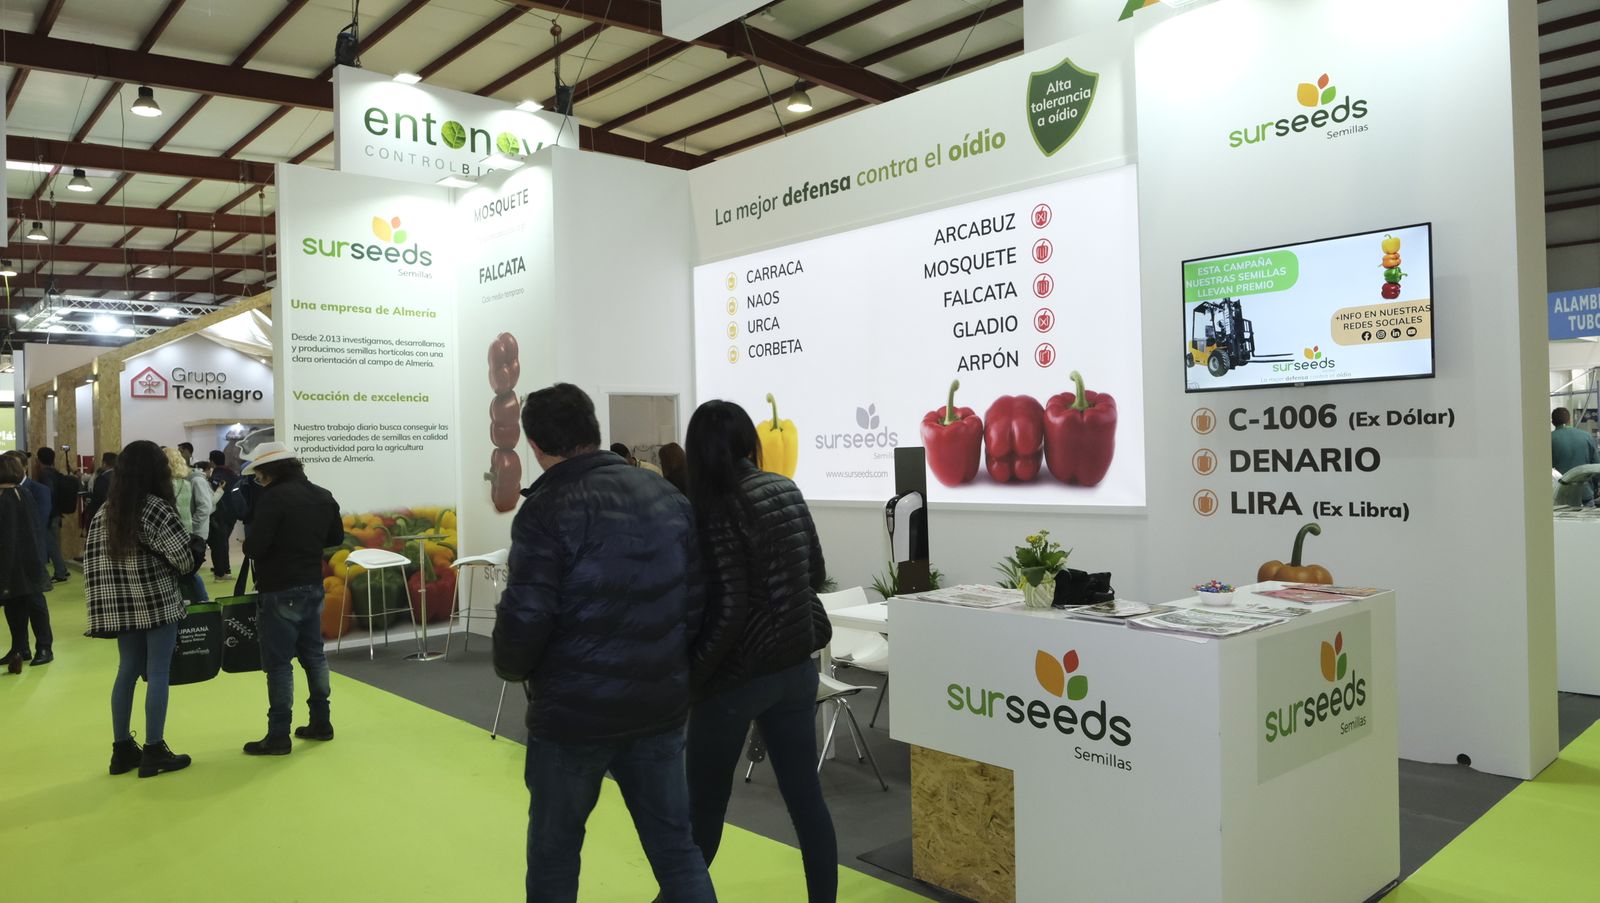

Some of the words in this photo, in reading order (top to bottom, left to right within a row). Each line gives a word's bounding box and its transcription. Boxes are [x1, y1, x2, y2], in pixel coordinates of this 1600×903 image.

[1046, 78, 1072, 95] Alta
[1030, 86, 1092, 113] tolerancia
[1037, 116, 1046, 127] a
[1048, 107, 1078, 125] oídio
[1228, 95, 1368, 148] surseeds
[1326, 122, 1369, 140] Semillas
[714, 208, 732, 226] La
[736, 196, 779, 220] mejor
[782, 173, 852, 208] defensa
[856, 154, 918, 187] contra
[924, 143, 942, 169] el
[948, 128, 1006, 162] oídio
[474, 188, 528, 223] MOSQUETE
[933, 212, 1016, 245] ARCABUZ
[302, 237, 433, 267] surseeds
[479, 256, 526, 284] FALCATA
[746, 260, 804, 285] CARRACA
[923, 247, 1017, 280] MOSQUETE
[1197, 266, 1221, 276] ESTA
[1223, 257, 1272, 272] CAMPAÑA
[398, 268, 433, 280] Semillas
[1186, 275, 1236, 288] NUESTRAS
[1238, 267, 1287, 281] SEMILLAS
[943, 281, 1018, 308] FALCATA
[1197, 286, 1233, 298] LLEVAN
[1236, 280, 1274, 292] PREMIO
[291, 299, 317, 310] Una
[320, 302, 372, 315] empresa
[375, 305, 390, 315] de
[392, 306, 436, 318] Almería
[746, 291, 780, 309] NAOS
[1335, 312, 1362, 321] +INFO
[1364, 310, 1377, 318] EN
[1380, 304, 1431, 316] NUESTRAS
[1343, 320, 1373, 330] REDES
[1375, 315, 1423, 328] SOCIALES
[747, 316, 780, 334] URCA
[952, 315, 1018, 339] GLADIO
[291, 333, 317, 342] Desde
[319, 334, 341, 343] 2.013
[342, 336, 394, 346] investigamos,
[395, 339, 446, 348] desarrollamos
[291, 345, 297, 353] y
[298, 345, 345, 353] producimos
[347, 347, 377, 355] semillas
[747, 339, 803, 359] CORBETA
[291, 355, 313, 363] clara
[313, 356, 357, 365] orientación
[367, 359, 393, 367] campo
[957, 347, 1020, 373] ARPÓN
[1272, 357, 1336, 373] surseeds
[171, 367, 227, 386] Grupo
[172, 385, 264, 404] Tecniagro
[292, 390, 350, 401] Vocación
[353, 391, 368, 401] de
[370, 392, 429, 403] excelencia
[1228, 403, 1338, 431] C-1006
[1348, 411, 1381, 431] (Ex
[1386, 408, 1456, 428] Dólar)
[293, 423, 326, 431] Nuestro
[326, 423, 355, 432] trabajo
[356, 423, 379, 431] diario
[379, 423, 402, 431] busca
[403, 423, 437, 432] conseguir
[438, 423, 449, 431] las
[815, 426, 898, 449] surseeds
[293, 434, 326, 443] mejores
[382, 433, 411, 441] semillas
[422, 433, 448, 441] calidad
[300, 444, 355, 454] productividad
[356, 445, 375, 453] para
[384, 444, 424, 453] agricultura
[331, 455, 342, 463] de
[1229, 447, 1381, 473] DENARIO
[826, 469, 888, 478] www.surseeds.com
[1230, 491, 1303, 516] LIRA
[1312, 500, 1343, 520] (Ex
[1349, 501, 1410, 522] Libra)
[947, 683, 1132, 747] surseeds
[1265, 670, 1367, 743] surseeds
[1340, 714, 1367, 736] Semillas
[1074, 746, 1133, 772] Semillas
